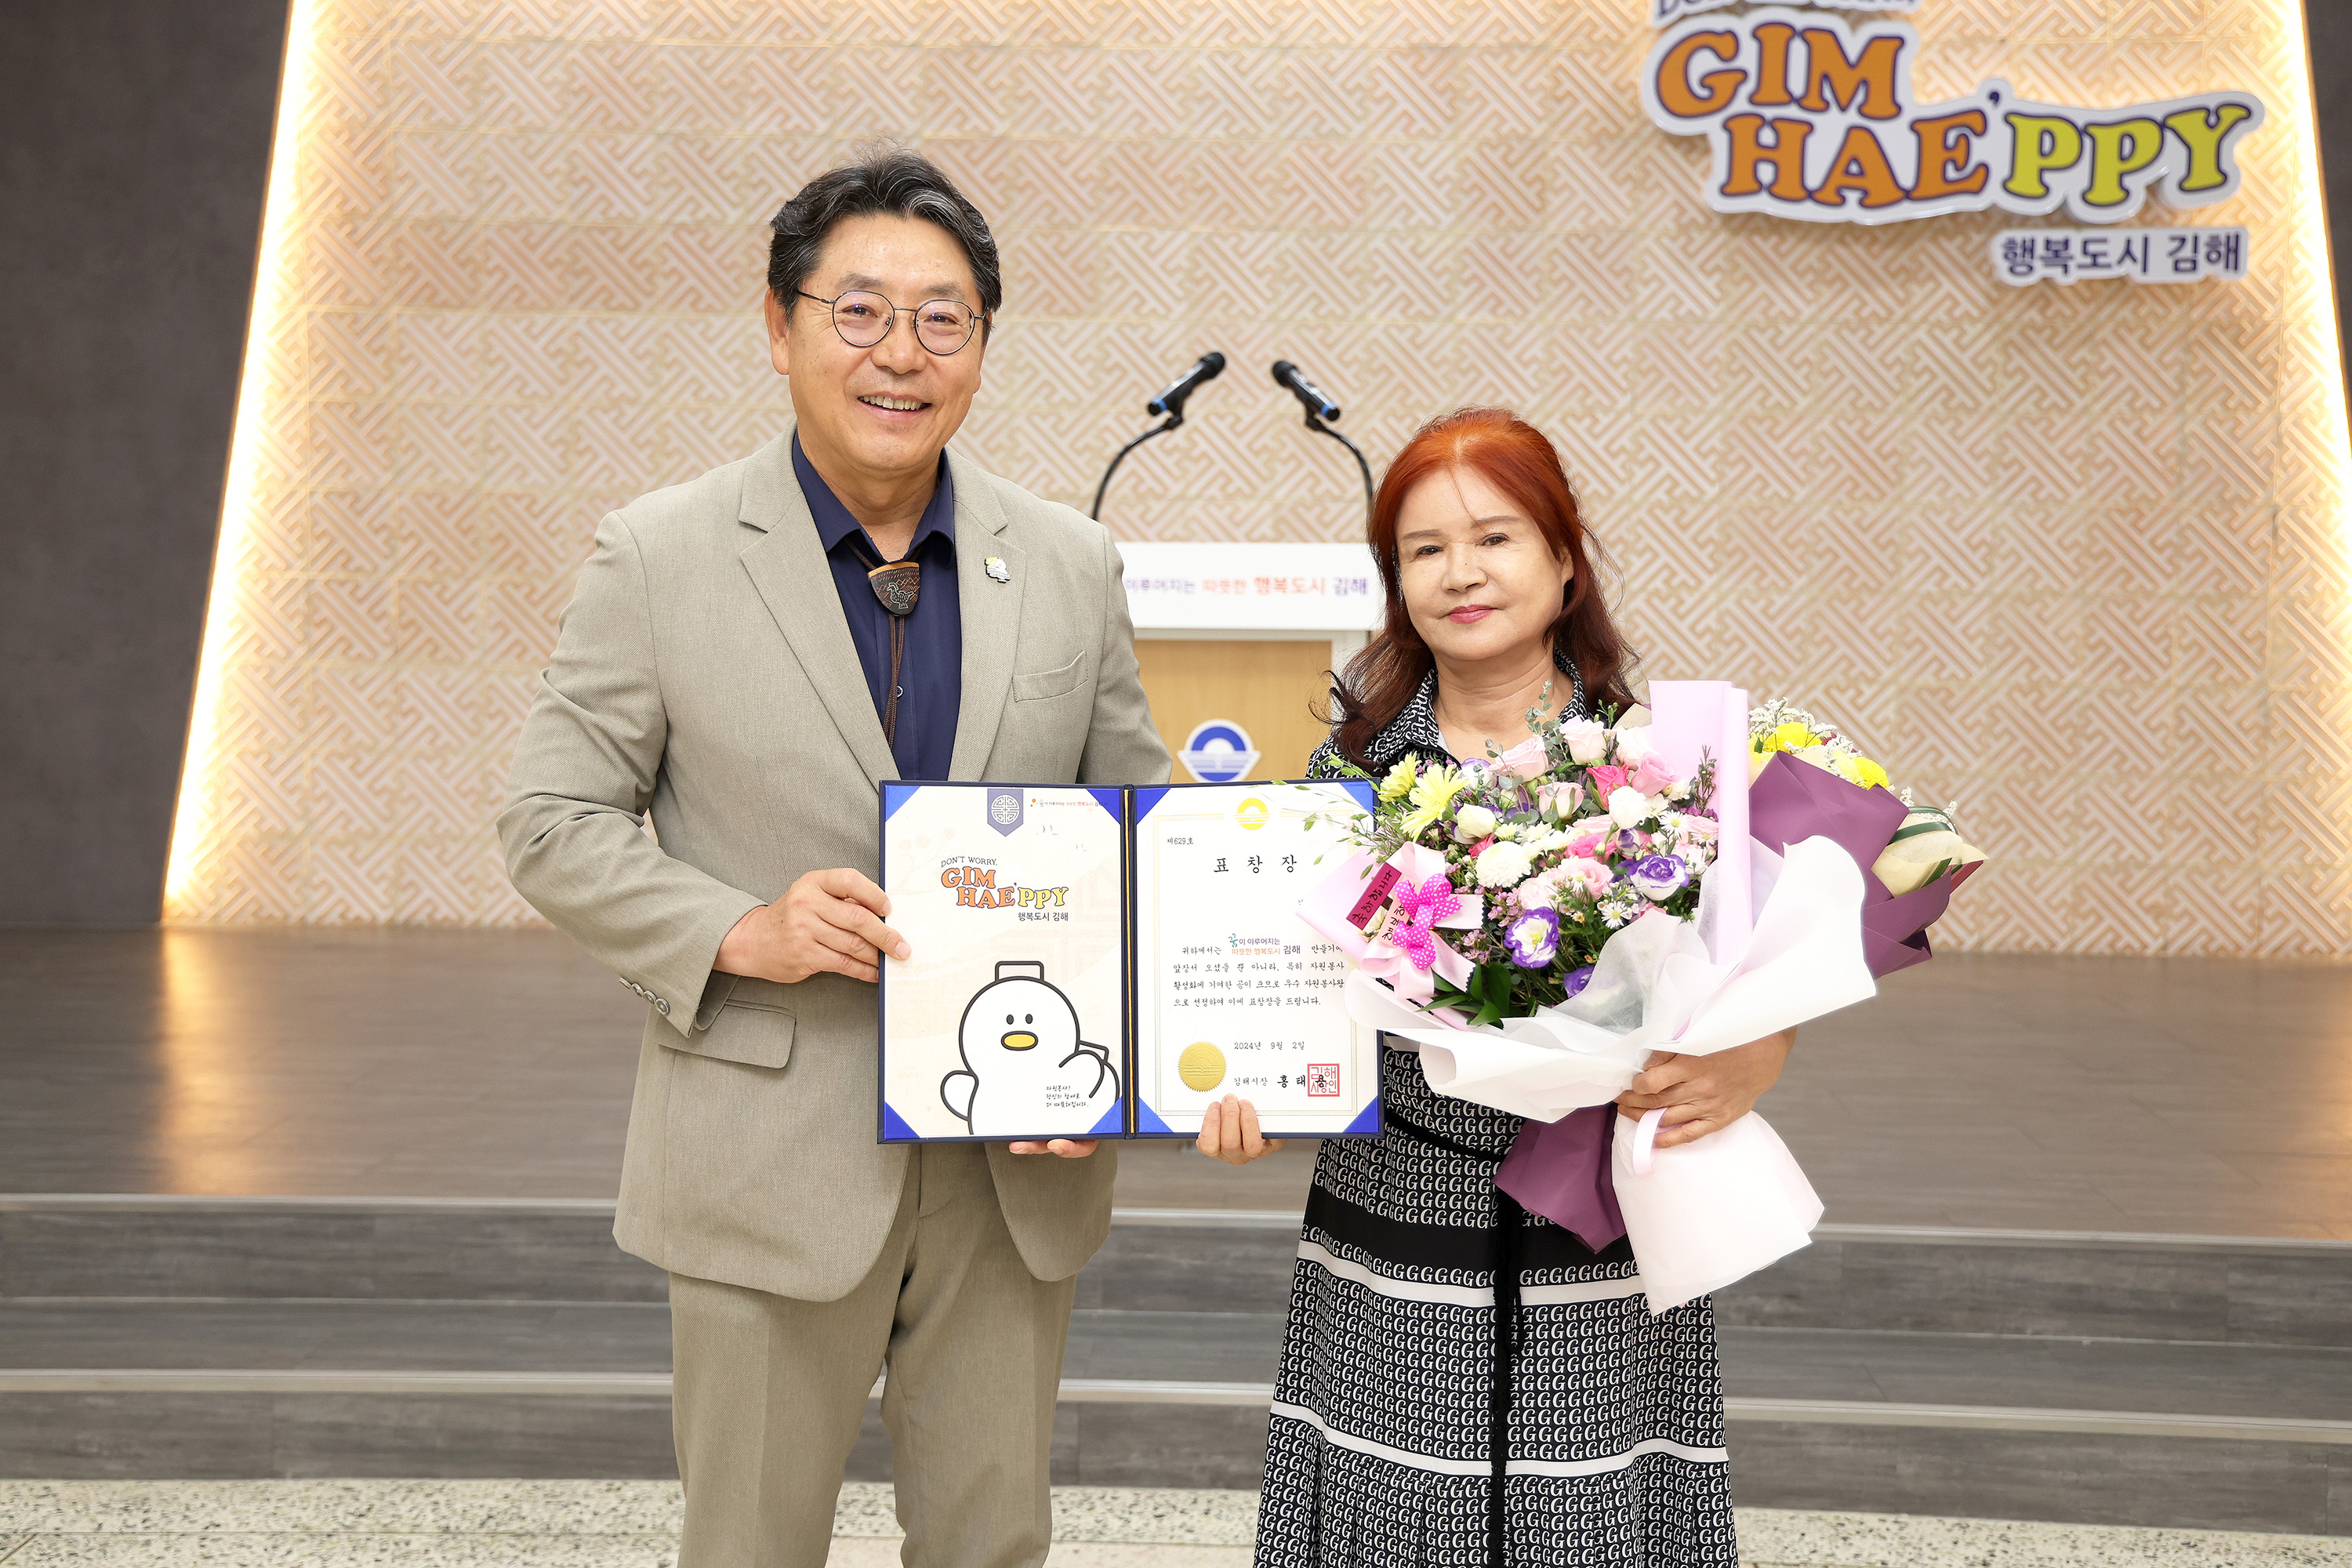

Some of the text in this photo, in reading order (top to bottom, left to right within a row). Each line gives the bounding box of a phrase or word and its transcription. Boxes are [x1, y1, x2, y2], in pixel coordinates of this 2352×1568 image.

[1655, 22, 1905, 121] GIM
[1719, 90, 2253, 209] HAE'PPY
[2002, 232, 2243, 277] 행복도시 김해
[1254, 575, 1327, 597] 행복도시
[1334, 575, 1368, 597] 김해
[1167, 837, 1194, 845] 제629호
[941, 855, 966, 868] DON'T
[941, 866, 996, 889] GIM
[1018, 912, 1069, 921] 행복도시 김해
[1254, 947, 1280, 956] 행복도시
[1283, 945, 1301, 955] 김해
[1173, 964, 1197, 973] 앞장서
[1287, 962, 1302, 971] 특히
[1174, 980, 1204, 990] 활성화에
[1209, 980, 1232, 989] 기여한
[1236, 979, 1251, 989] 공이
[1284, 979, 1300, 989] 우수
[1304, 978, 1345, 989] 자원봉사왕
[1174, 996, 1321, 1007] 으로 선정하여 이에 표창장을 드립니다.
[1234, 1041, 1305, 1051] 2024년 9월 2일
[1234, 1076, 1269, 1087] 김해시장
